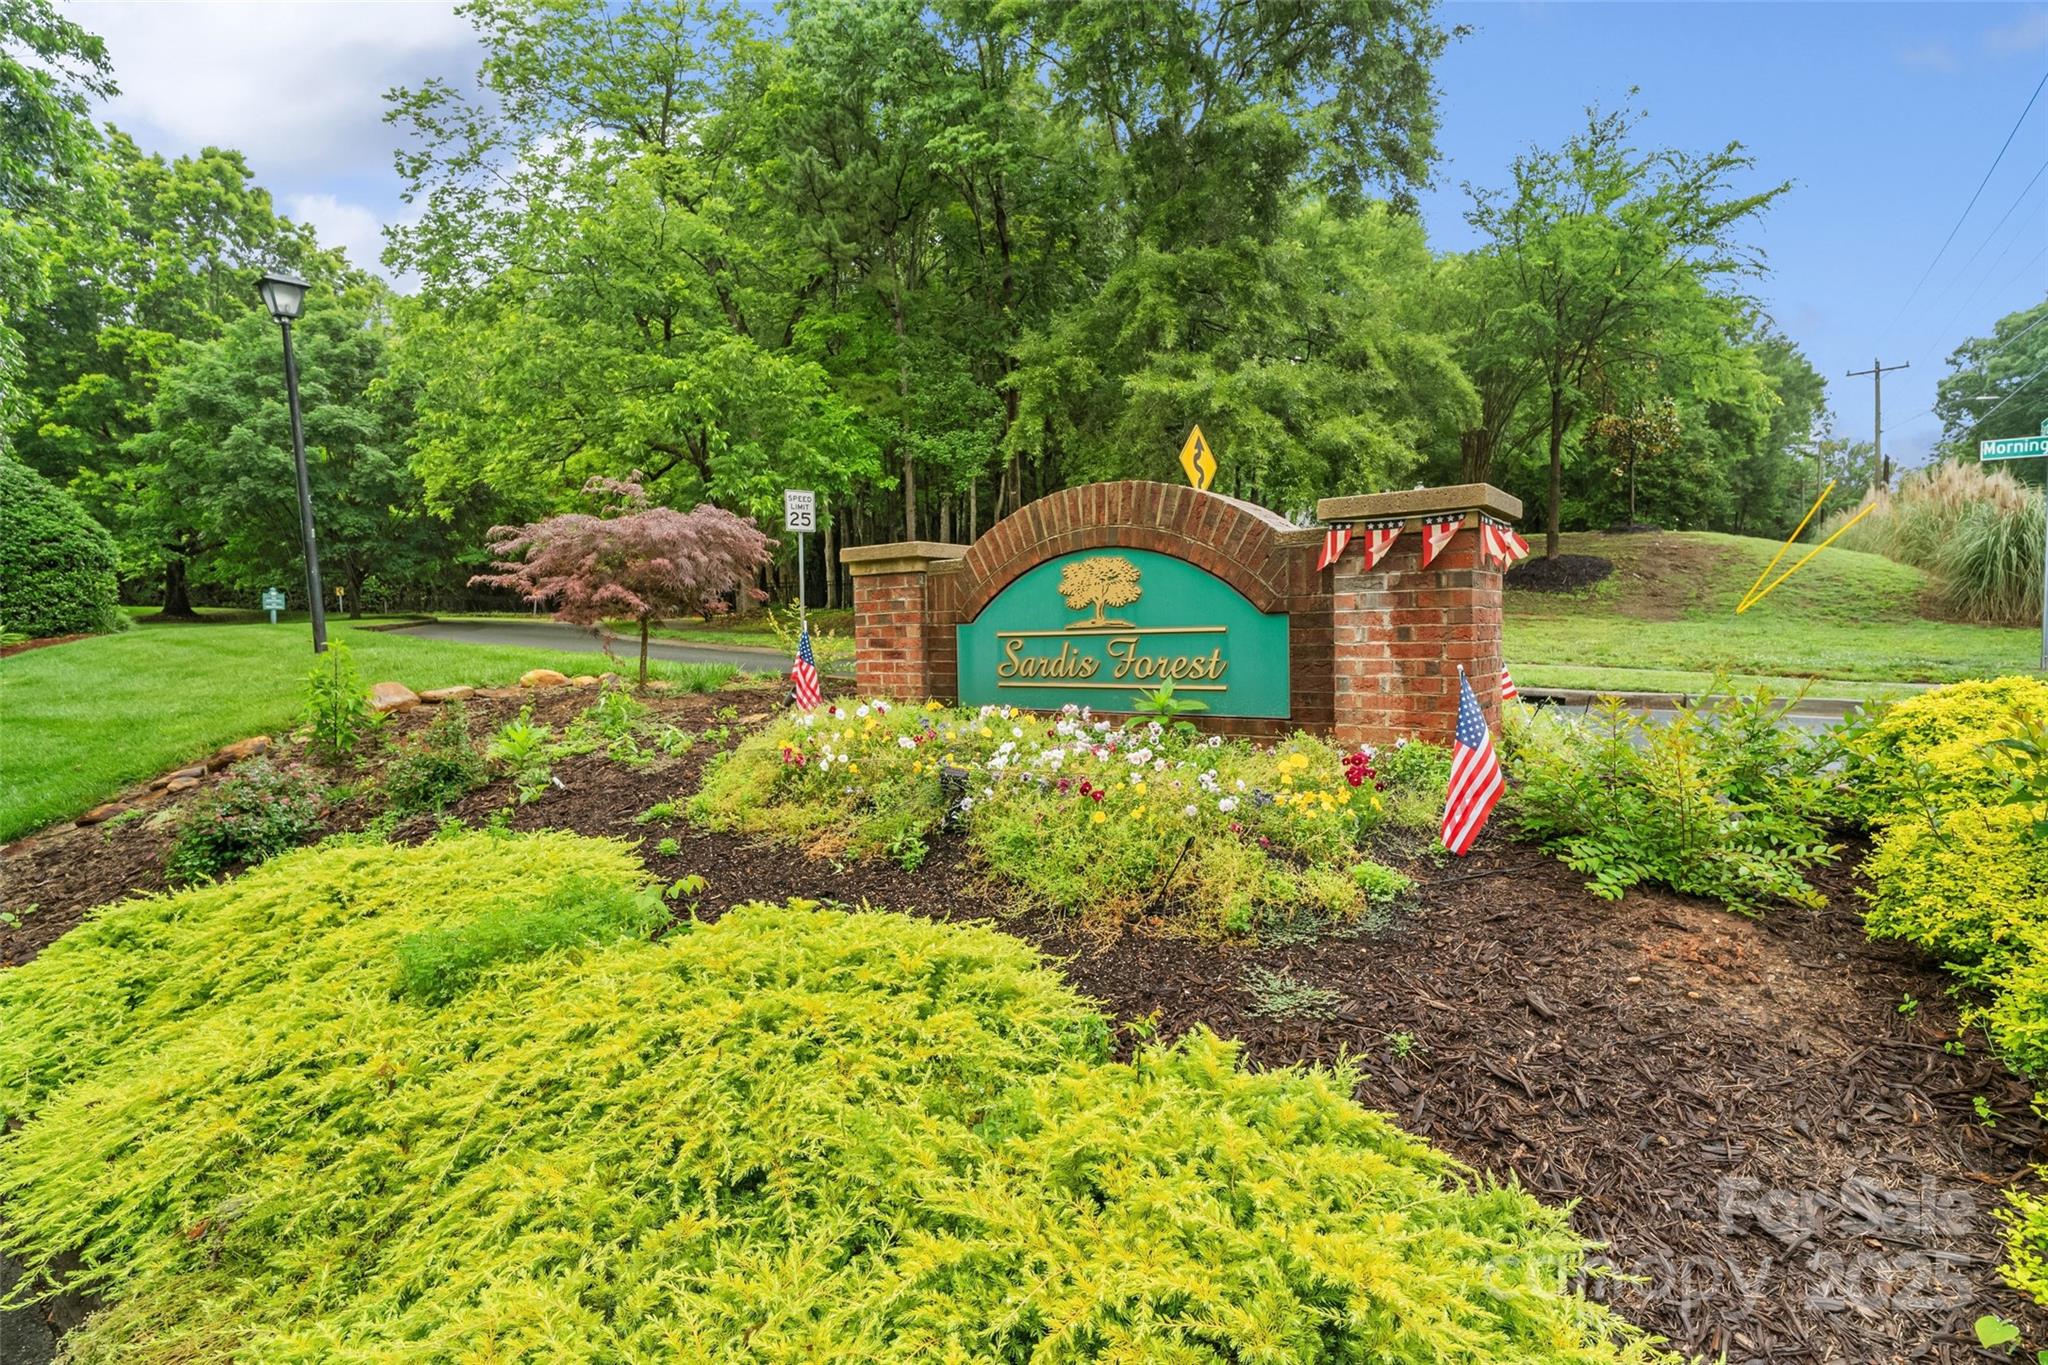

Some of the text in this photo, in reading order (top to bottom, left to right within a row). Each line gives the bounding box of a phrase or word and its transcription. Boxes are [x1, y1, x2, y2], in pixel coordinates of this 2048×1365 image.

[790, 512, 811, 526] 25
[998, 636, 1227, 679] Sardis Forest
